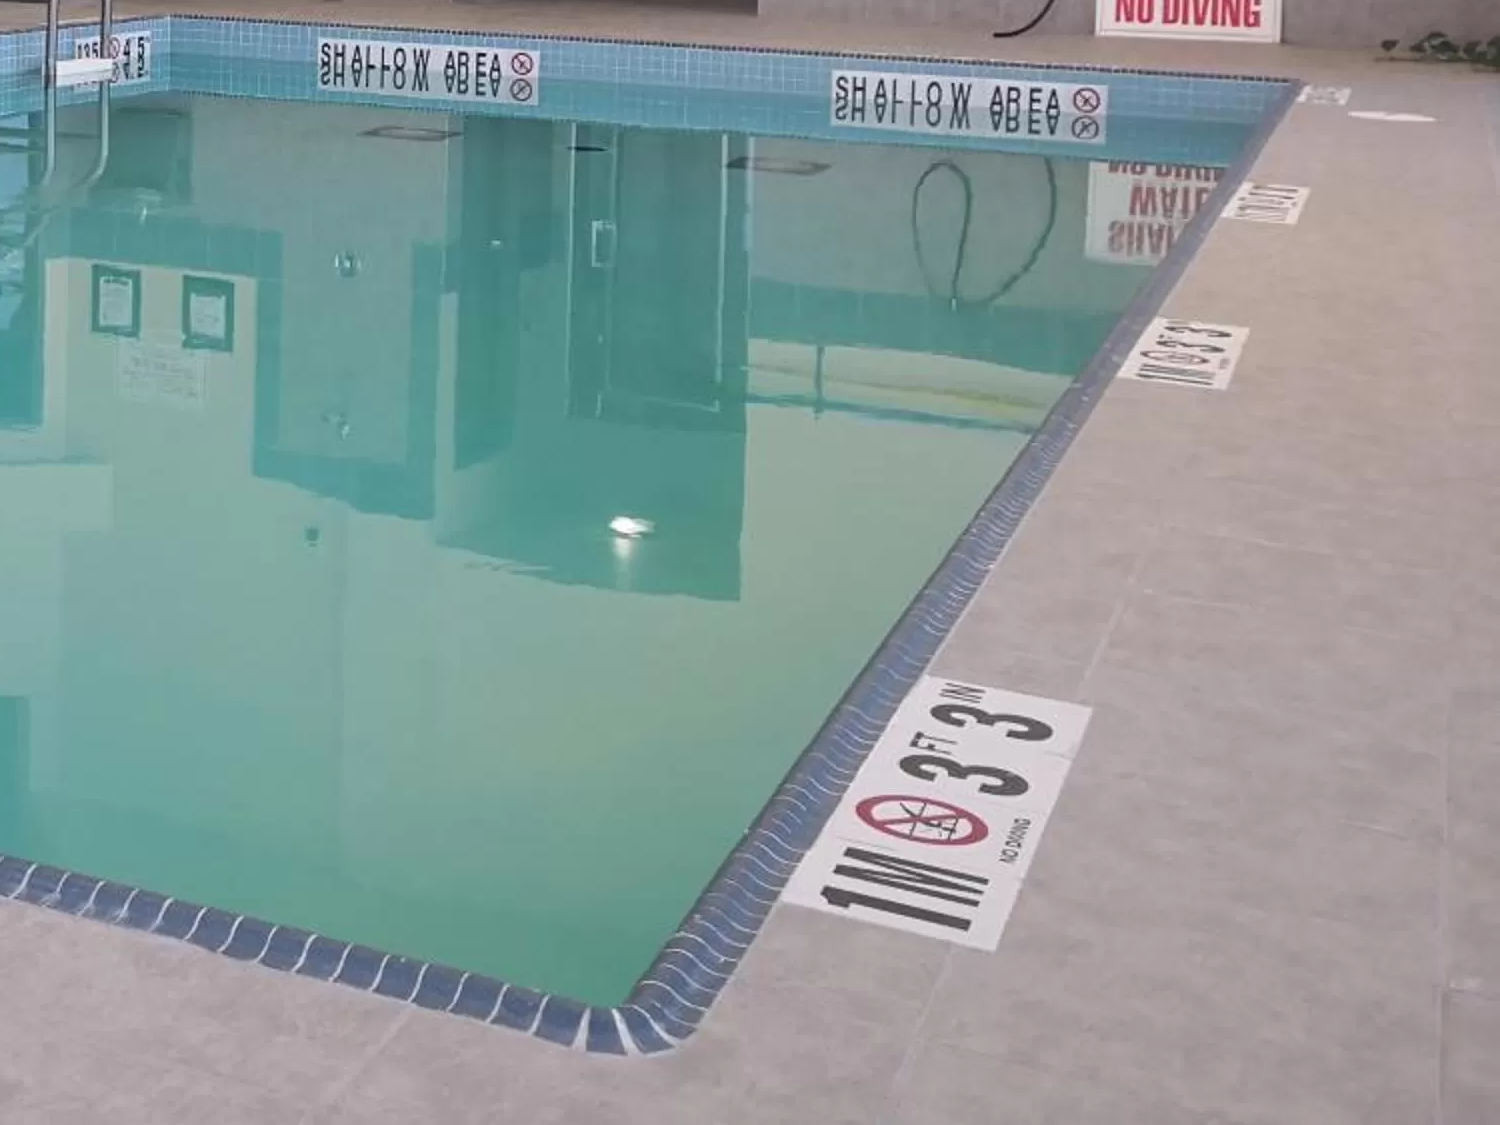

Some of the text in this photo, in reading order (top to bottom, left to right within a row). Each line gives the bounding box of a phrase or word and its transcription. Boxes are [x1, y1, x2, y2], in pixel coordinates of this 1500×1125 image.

[320, 43, 502, 78] SHALLOW AREA
[835, 76, 1061, 116] SHALLOW AREA
[819, 845, 990, 933] 1M
